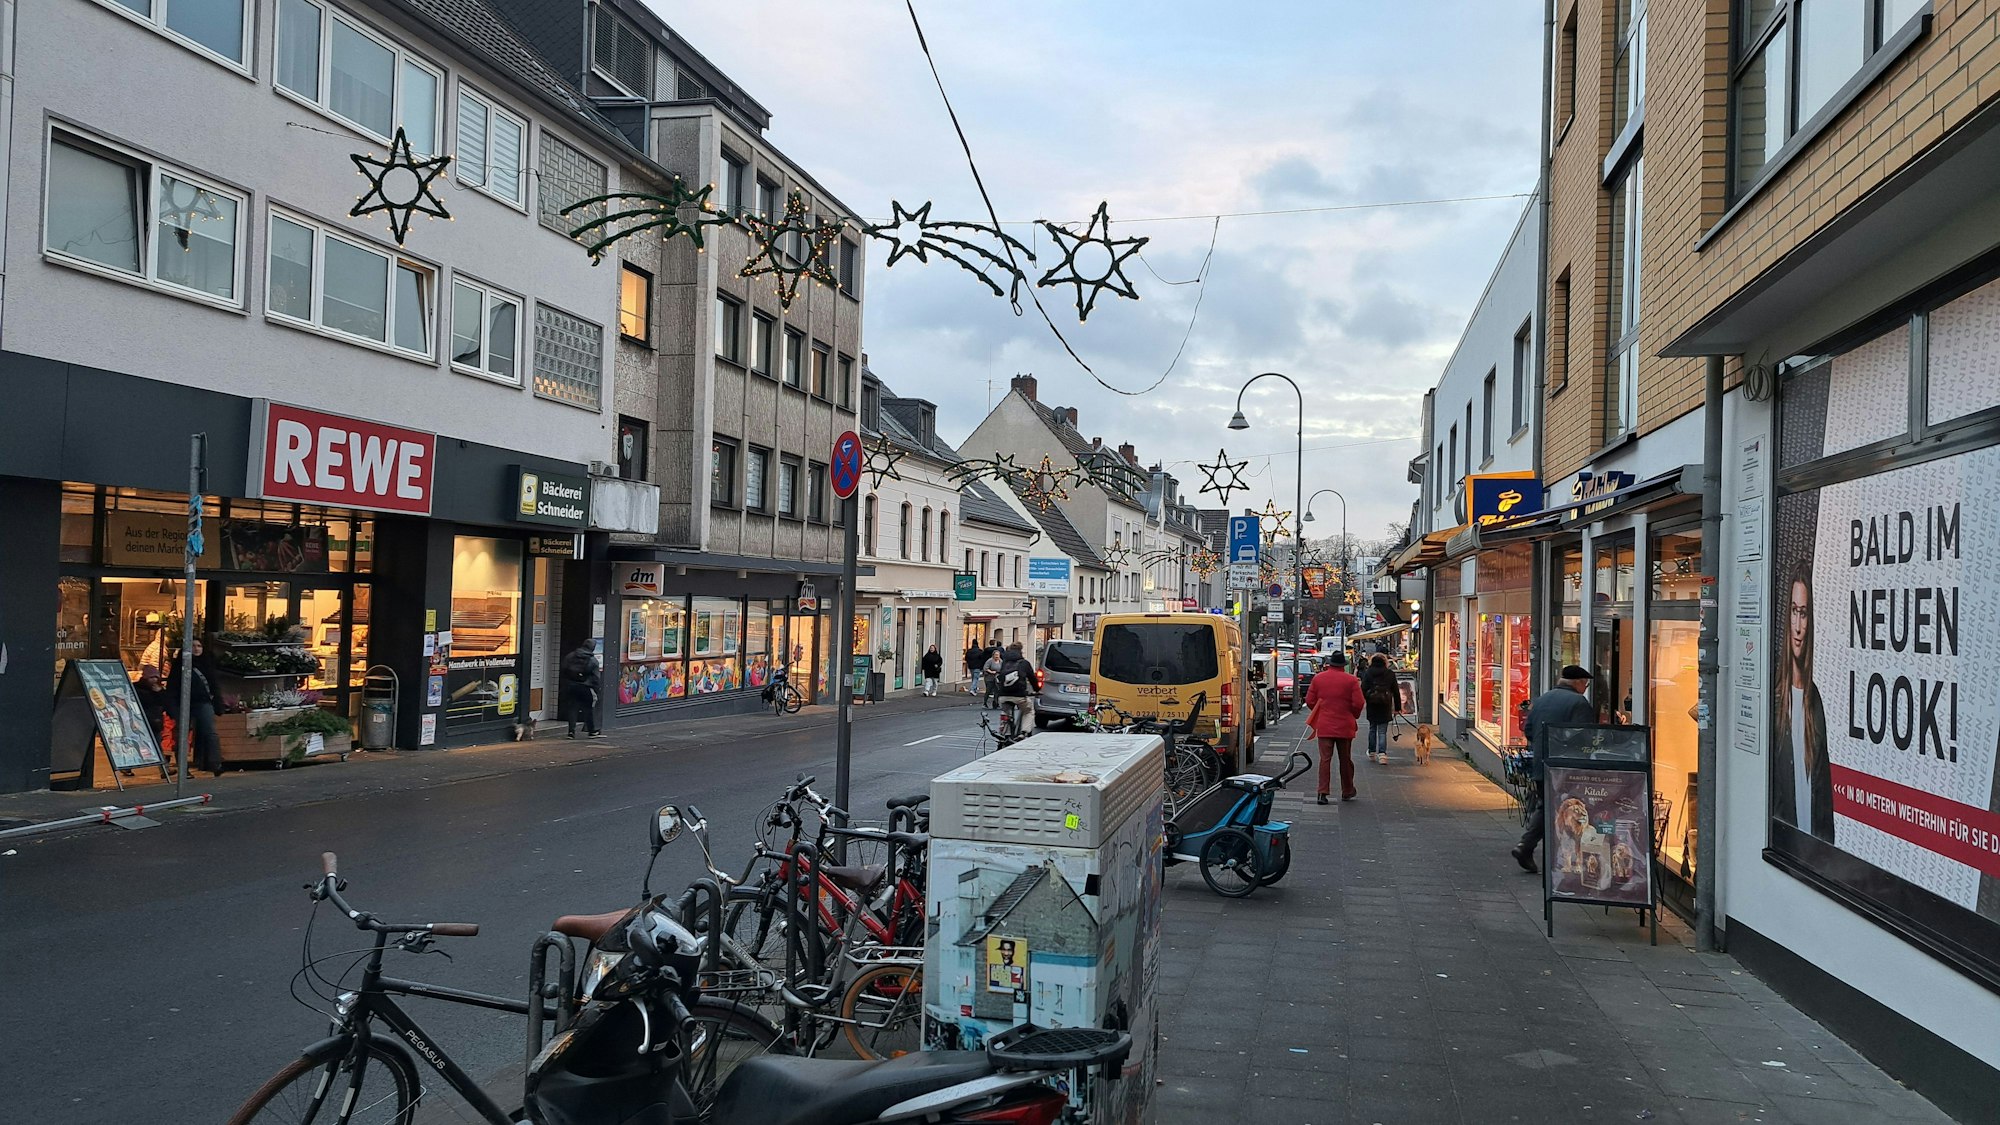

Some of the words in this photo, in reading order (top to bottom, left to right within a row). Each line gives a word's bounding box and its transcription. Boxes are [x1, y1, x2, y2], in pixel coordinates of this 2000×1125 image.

[274, 418, 425, 500] REWE
[542, 481, 582, 501] Bäckerei
[537, 501, 584, 520] Schneider
[125, 526, 143, 538] Aus
[145, 528, 160, 539] der
[162, 528, 187, 542] Regio
[543, 538, 572, 546] Bäckerei
[1850, 510, 1915, 568] BALD
[1926, 502, 1961, 562] IM
[125, 541, 155, 553] deinen
[157, 542, 185, 555] Markt
[540, 547, 574, 555] Schneider
[630, 568, 655, 583] dm
[801, 578, 816, 599] dm
[1850, 586, 1959, 657] NEUEN
[448, 660, 478, 669] Handwerk
[478, 659, 485, 667] in
[485, 658, 516, 668] Vollendung
[1136, 685, 1178, 695] verbert
[1849, 670, 1958, 763] LOOK!
[1584, 786, 1609, 797] Kitale
[1846, 784, 1855, 801] IN
[1855, 787, 1865, 805] 80
[1866, 791, 1897, 816] METERN
[1898, 802, 1946, 835] WEITERHIN
[1949, 817, 1969, 843] FÜR
[1971, 828, 1989, 851] SIE
[405, 1029, 446, 1070] PEGASUS
